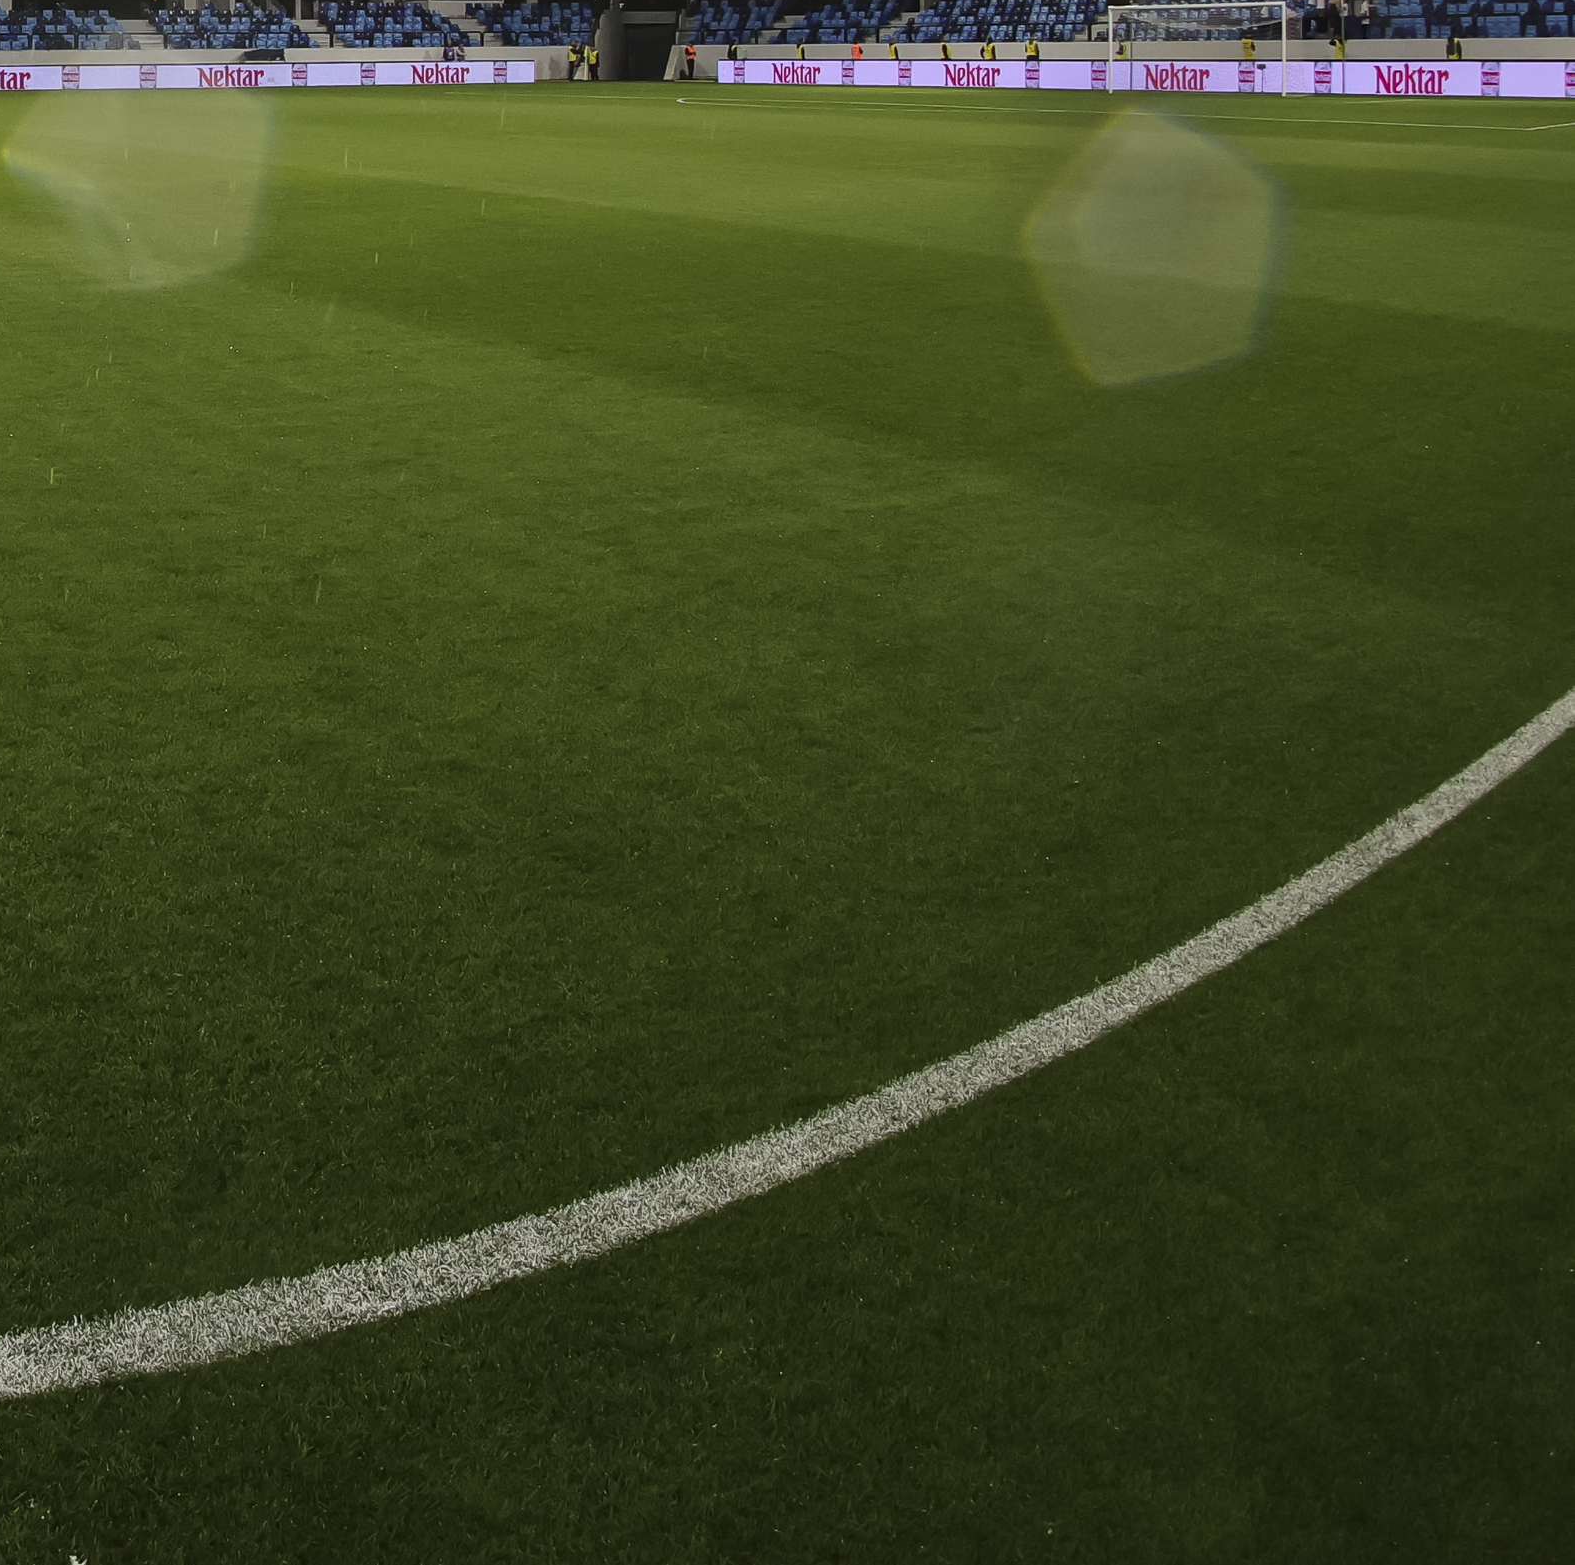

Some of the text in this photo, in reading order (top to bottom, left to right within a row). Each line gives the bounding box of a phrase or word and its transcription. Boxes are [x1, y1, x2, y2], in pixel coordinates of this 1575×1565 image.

[197, 65, 264, 88] Nektar
[410, 63, 470, 84] Nektar
[771, 62, 821, 84] Nektar
[943, 62, 1001, 88] Nektar
[1143, 62, 1210, 91] Nektar
[1373, 63, 1450, 95] Nektar
